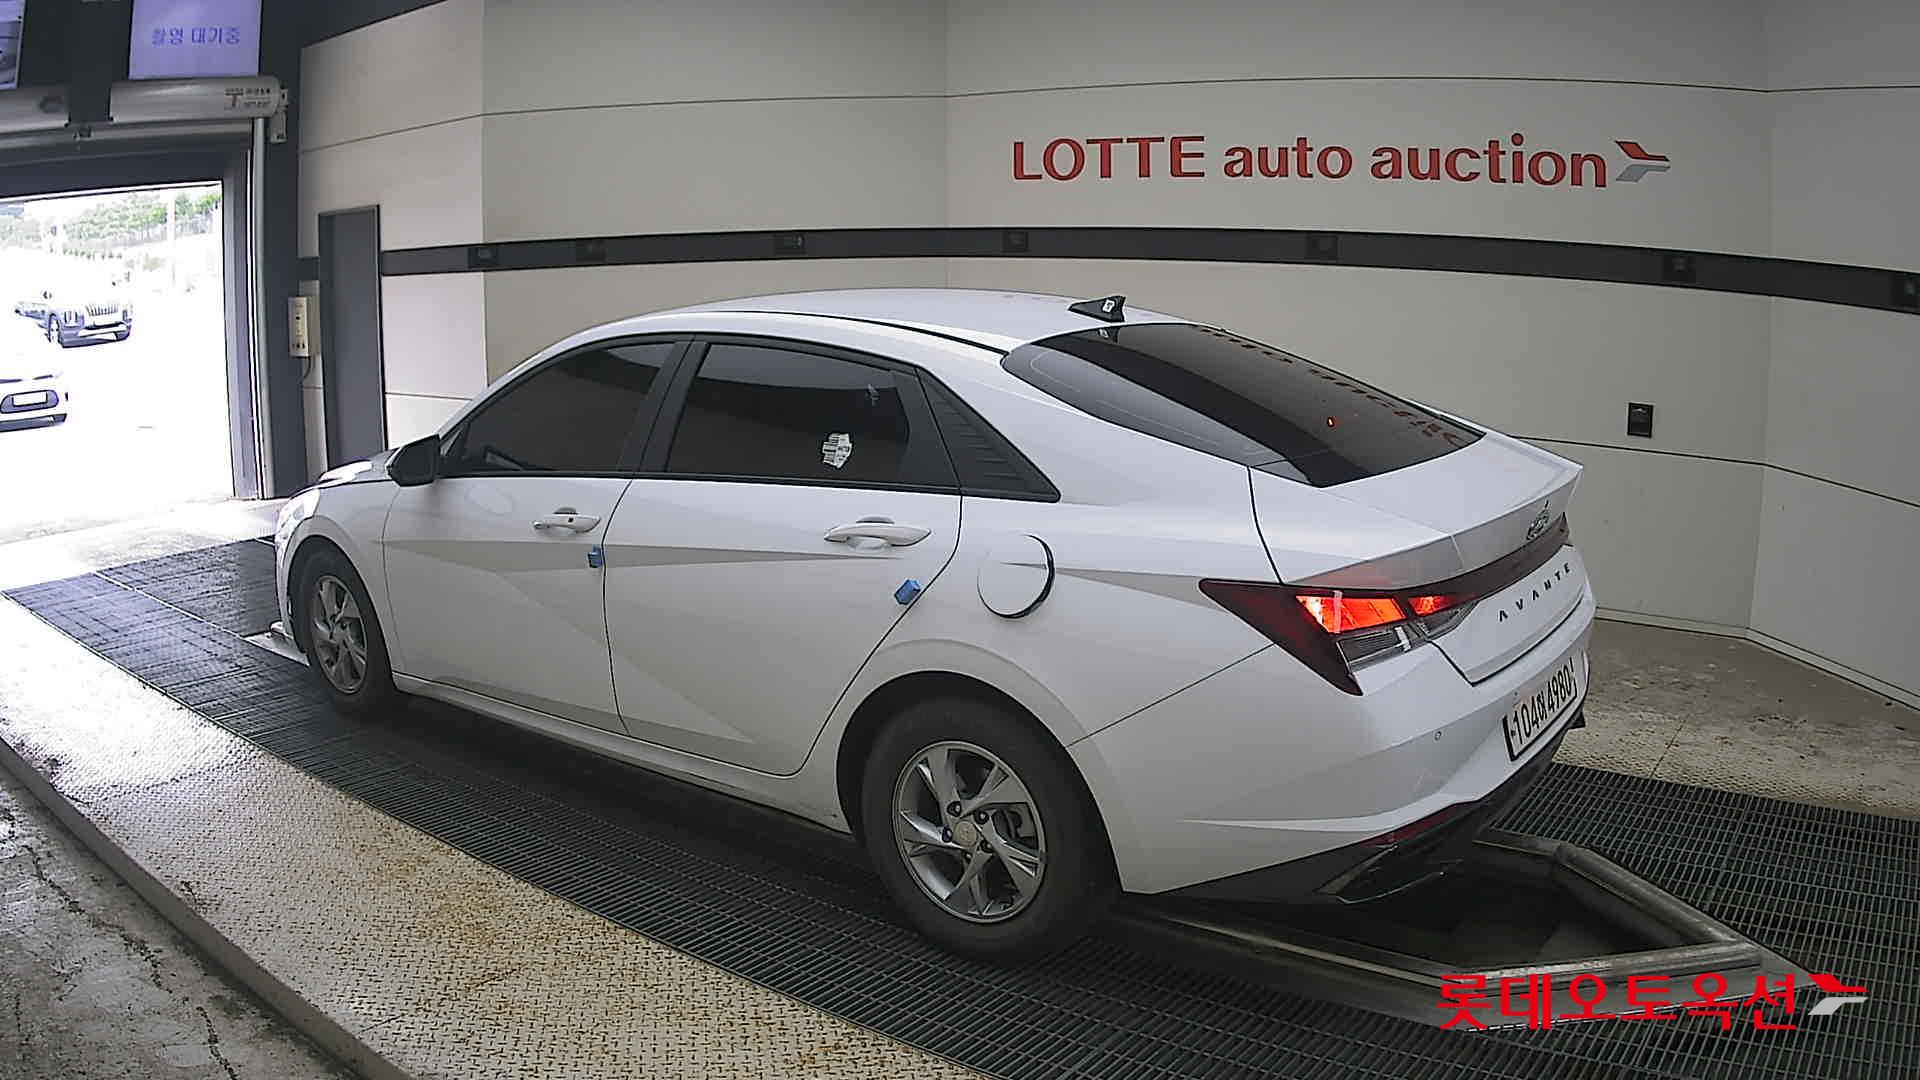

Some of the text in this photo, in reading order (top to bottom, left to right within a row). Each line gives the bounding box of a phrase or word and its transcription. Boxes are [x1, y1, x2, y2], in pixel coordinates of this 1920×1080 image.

[191, 27, 240, 45] 대기중
[1013, 133, 1607, 188] LOTTE auto auction
[1499, 562, 1570, 622] AVANTE
